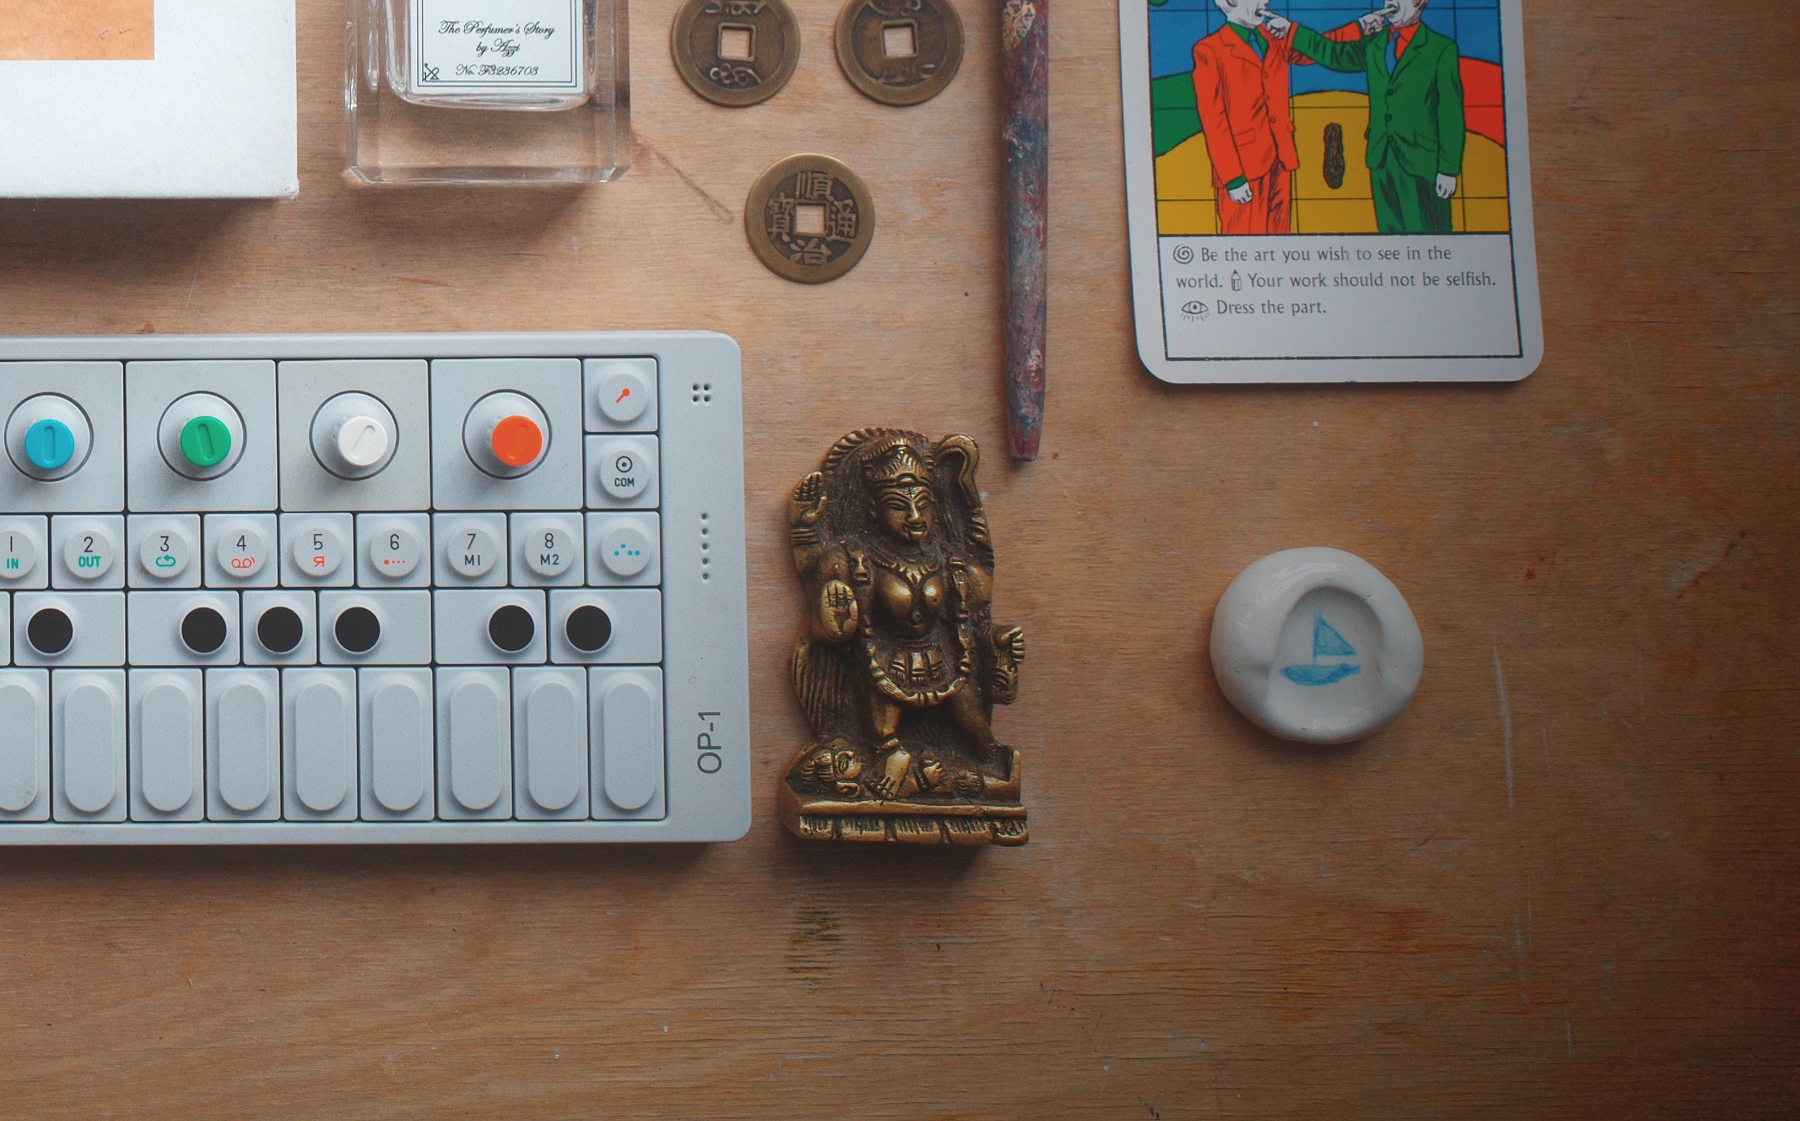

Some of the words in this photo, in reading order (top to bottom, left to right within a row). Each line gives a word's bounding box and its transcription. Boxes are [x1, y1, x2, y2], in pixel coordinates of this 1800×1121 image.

[438, 20, 461, 34] The
[524, 20, 555, 40] Story
[475, 41, 488, 57] by
[1201, 247, 1218, 262] Be
[1224, 247, 1248, 262] the
[1253, 248, 1275, 262] art
[1282, 250, 1310, 264] you
[1317, 246, 1350, 261] wish
[1356, 248, 1372, 261] to
[1377, 250, 1400, 261] see
[1407, 246, 1421, 260] in
[1428, 246, 1452, 260] the
[1176, 274, 1223, 289] world.
[1247, 273, 1283, 288] Your
[1290, 272, 1327, 287] work
[1333, 272, 1384, 287] should
[1390, 274, 1416, 287] not
[1422, 272, 1440, 286] be
[1446, 271, 1496, 287] selfish.
[1216, 300, 1255, 315] Dress
[1261, 300, 1285, 315] the
[1291, 301, 1327, 317] part.
[613, 477, 635, 488] COM
[83, 536, 94, 553] 2
[160, 535, 170, 552] 3
[236, 535, 247, 551] 4
[313, 533, 324, 550] 5
[389, 533, 400, 550] 6
[466, 533, 477, 550] 7
[544, 532, 554, 549] 8
[6, 558, 19, 569] IN
[78, 555, 102, 568] OUT
[464, 554, 481, 566] M1
[540, 553, 559, 566] M2
[697, 710, 722, 774] OP-1
